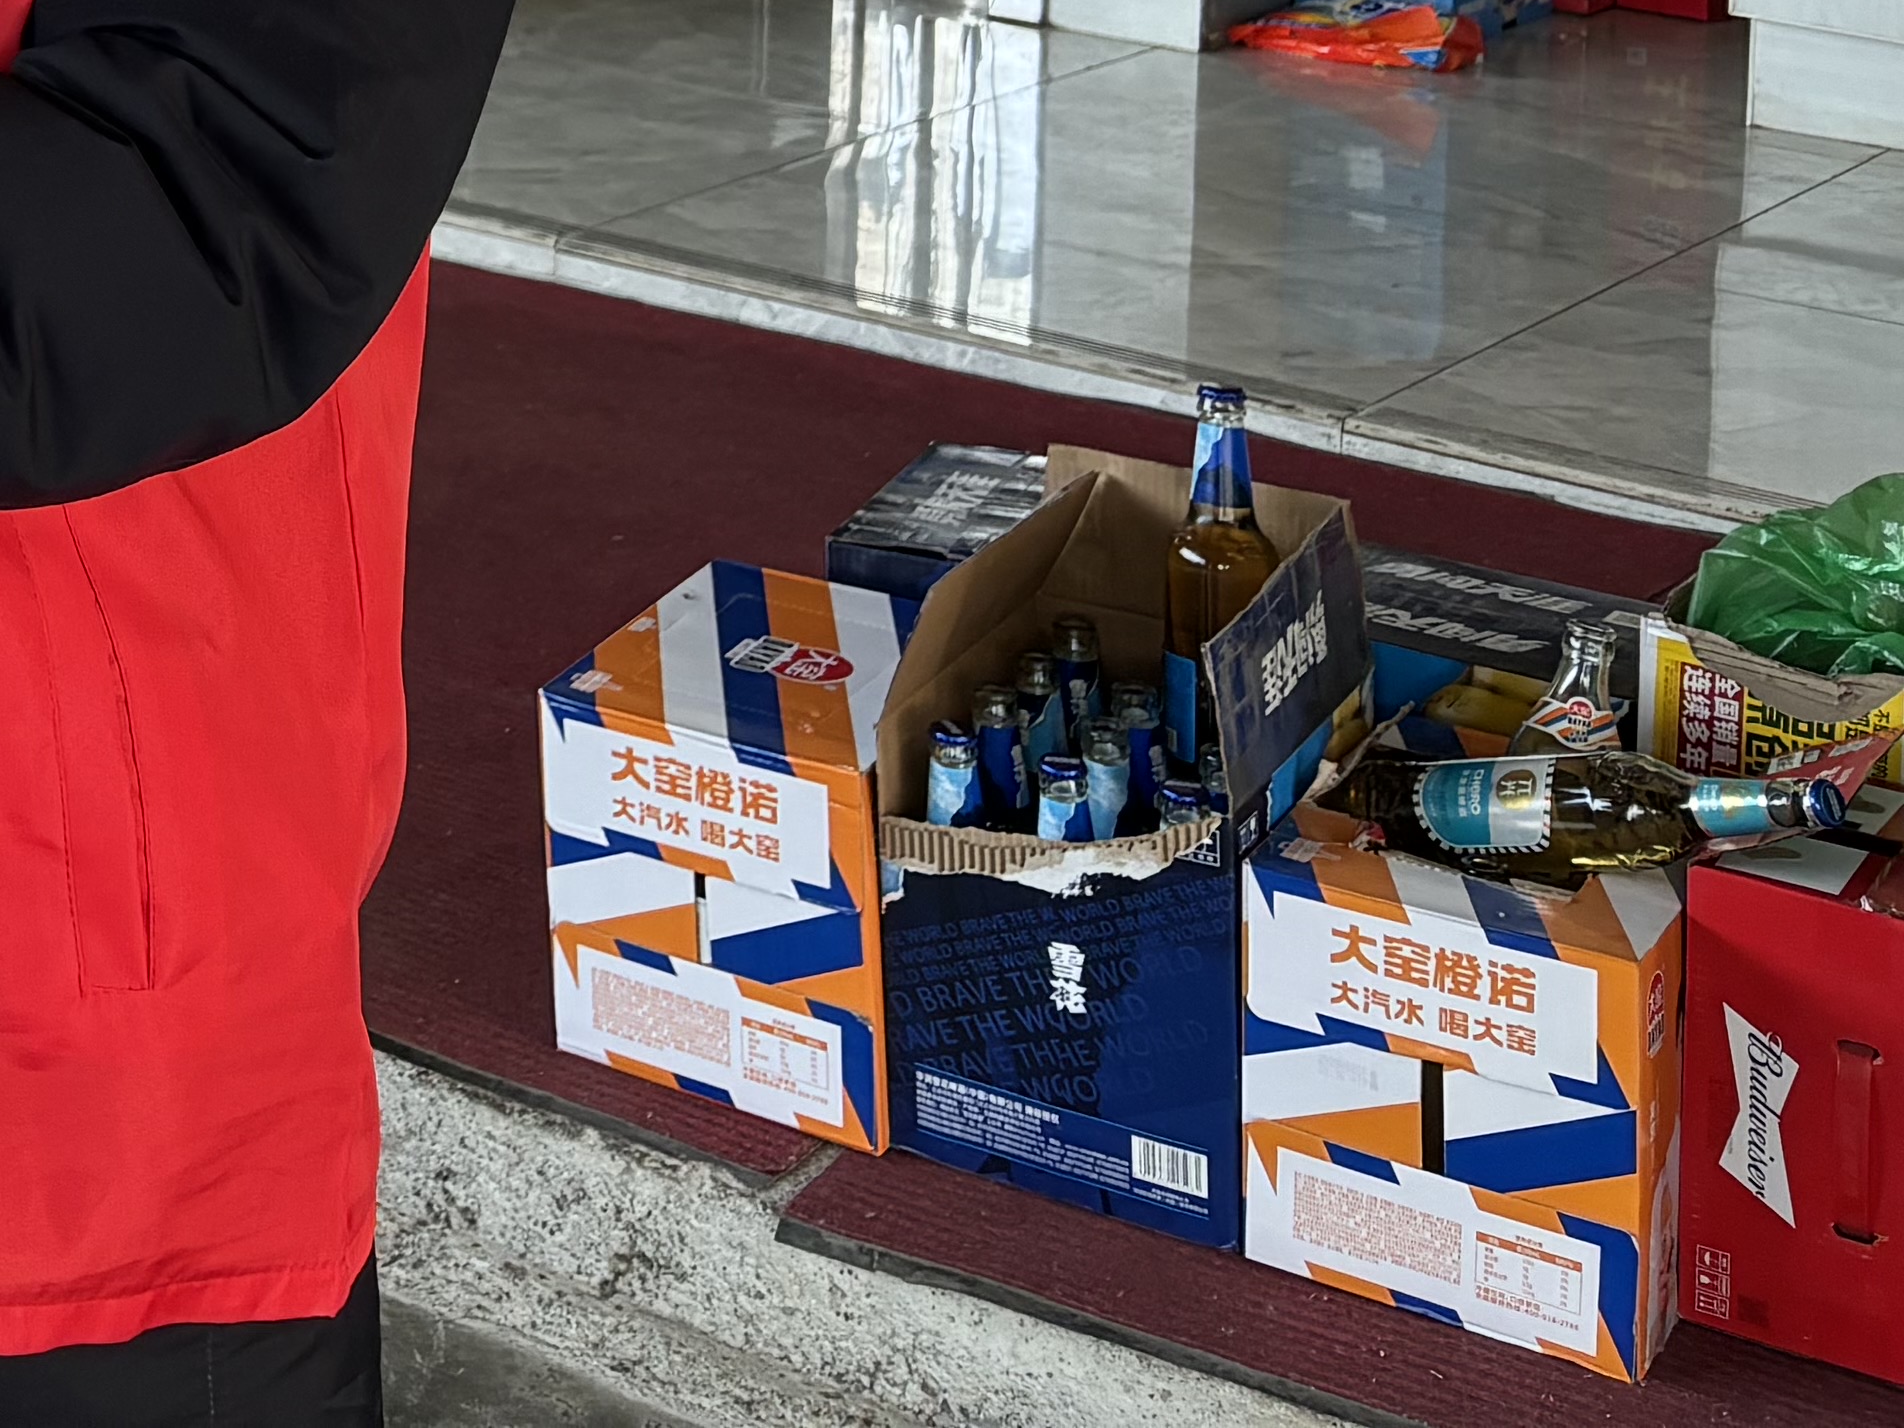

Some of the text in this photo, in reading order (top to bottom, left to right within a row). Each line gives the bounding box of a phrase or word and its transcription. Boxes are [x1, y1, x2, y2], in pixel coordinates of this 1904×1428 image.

[1679, 665, 1714, 774] 连续多年
[1711, 673, 1743, 768] 全国销量
[610, 745, 779, 825] 大窑橙诺
[612, 796, 780, 864] 大汽水 喝大窑
[1047, 941, 1087, 1015] 雪花
[1329, 923, 1537, 1015] 大窑橙诺
[1330, 980, 1537, 1057] 大汽水 喝大窑
[1747, 1031, 1785, 1200] Budweiser
